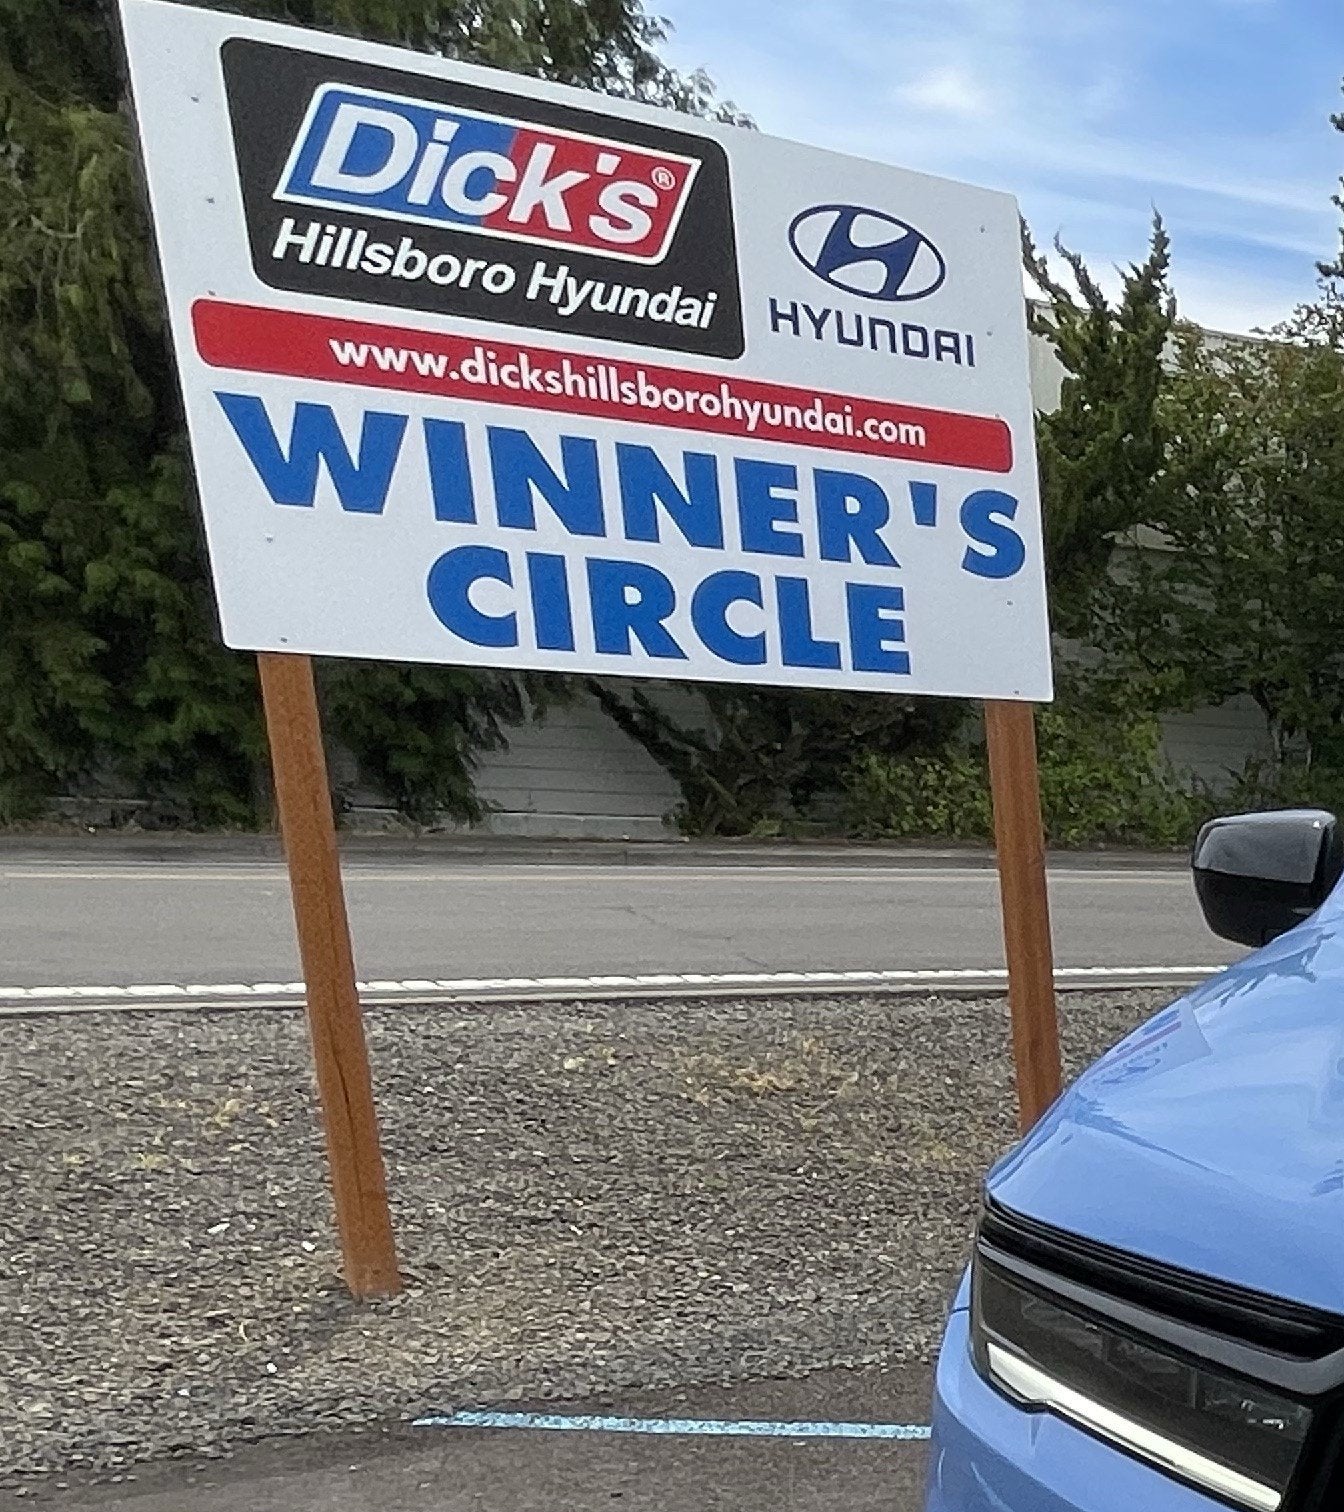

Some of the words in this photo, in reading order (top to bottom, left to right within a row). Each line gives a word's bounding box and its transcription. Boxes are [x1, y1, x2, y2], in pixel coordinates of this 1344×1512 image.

[309, 102, 659, 245] Dick's
[272, 217, 517, 294] Hillsboro
[526, 260, 718, 330] Hyundai
[768, 297, 976, 368] HYUNDAI
[328, 331, 927, 449] www.dickshillsborohyundai.com
[212, 390, 1028, 580] WINNER'S
[425, 544, 912, 676] CIRCLE
